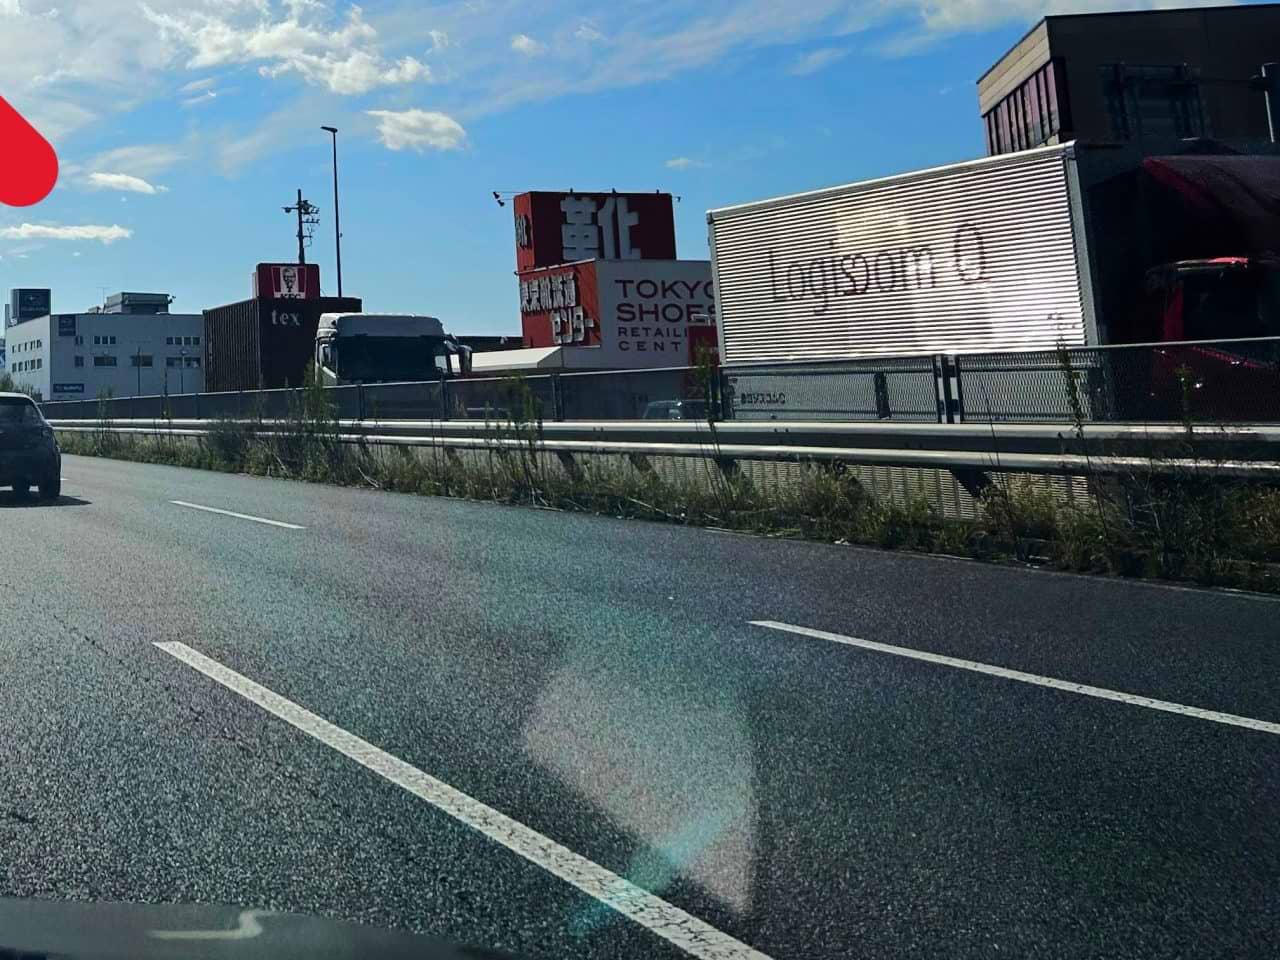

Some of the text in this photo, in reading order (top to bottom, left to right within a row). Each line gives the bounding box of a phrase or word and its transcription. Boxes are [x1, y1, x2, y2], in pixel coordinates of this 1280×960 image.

[560, 197, 640, 260] 靴
[271, 309, 301, 327] tex
[551, 306, 595, 345] センター
